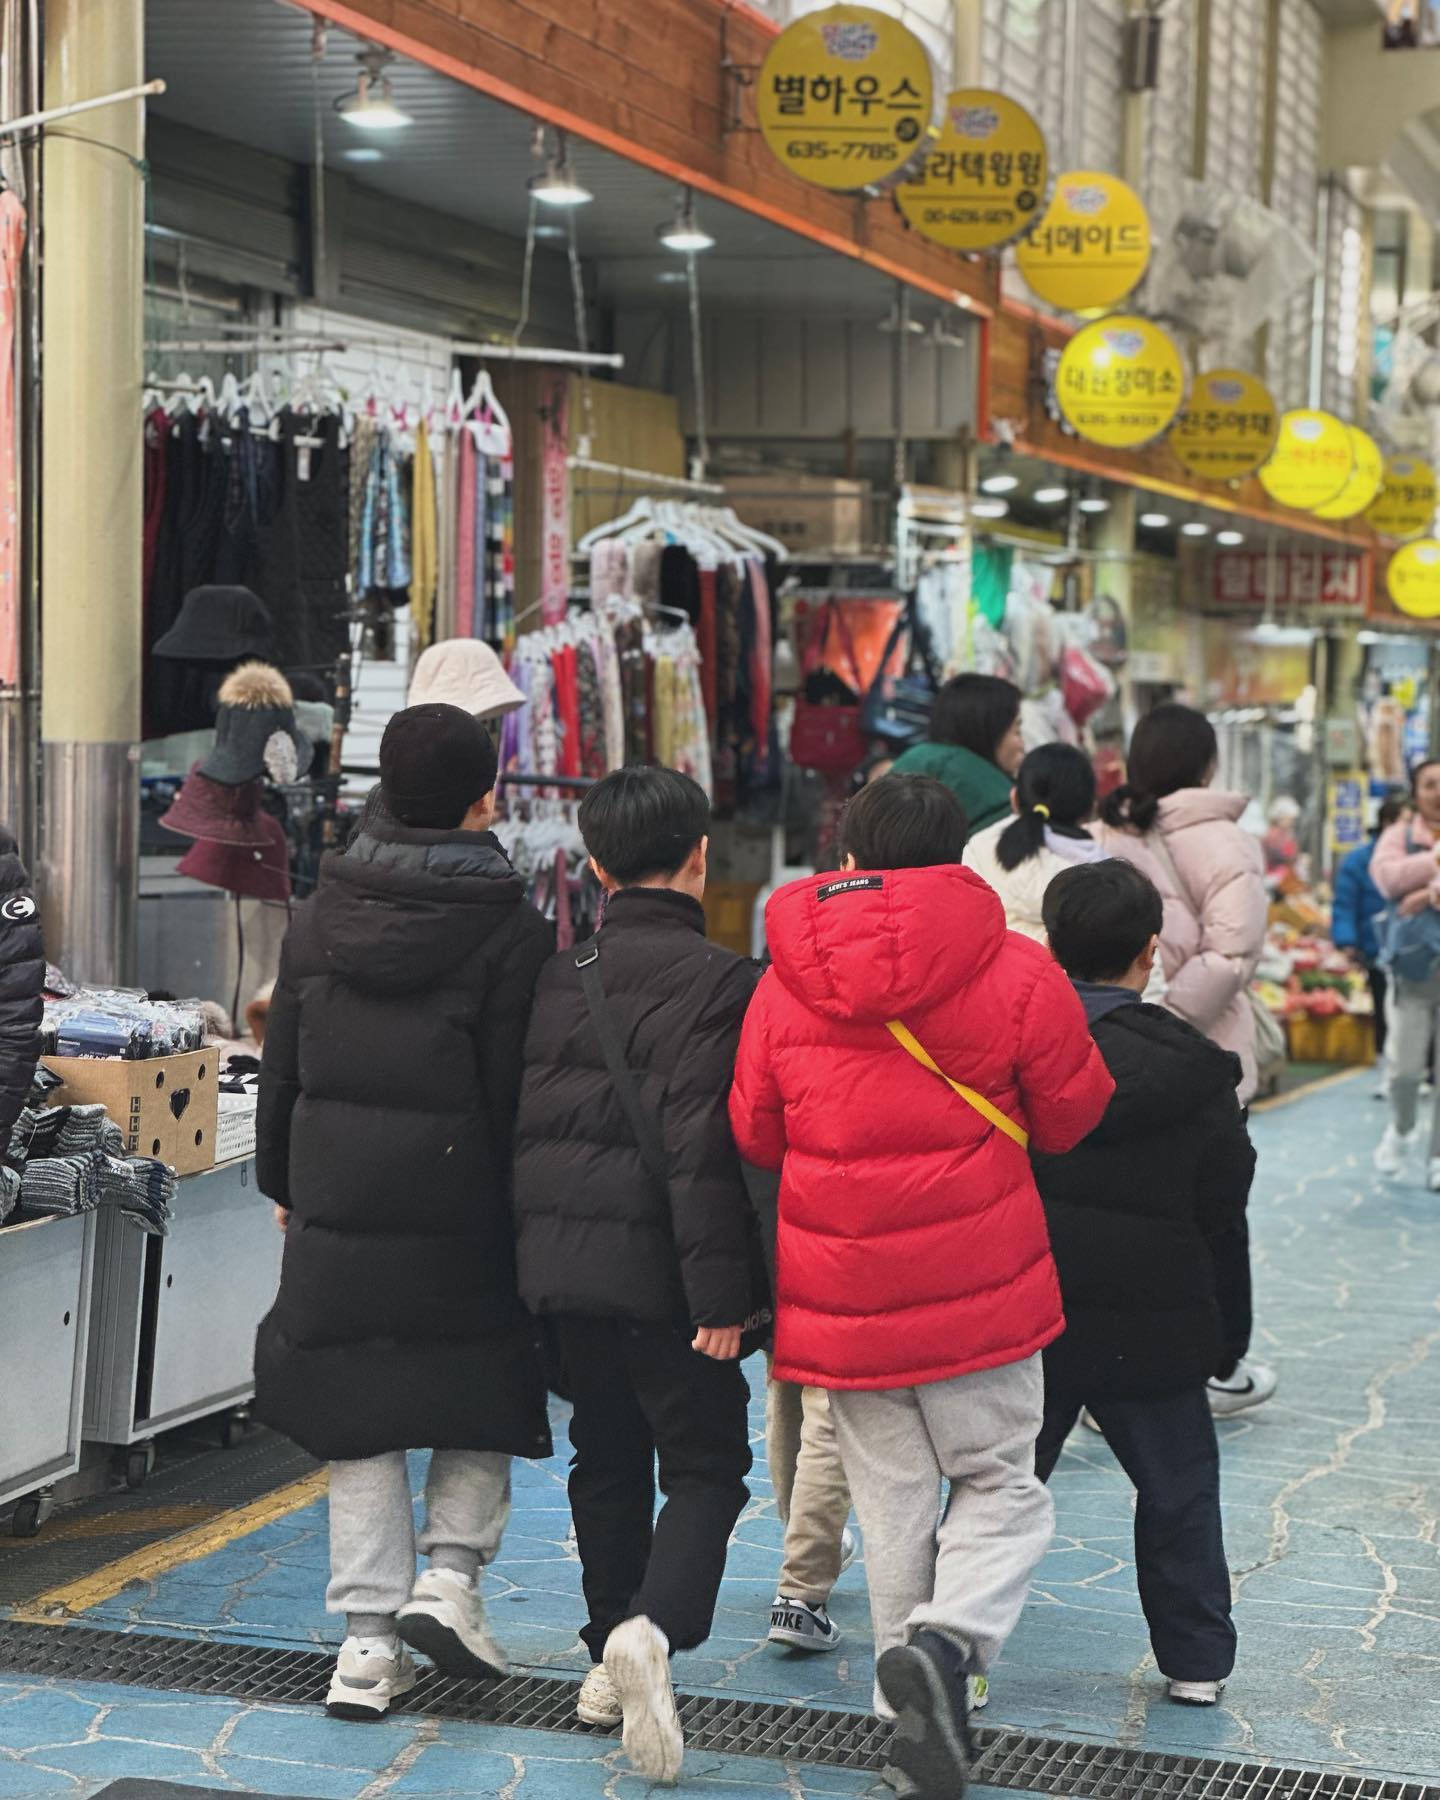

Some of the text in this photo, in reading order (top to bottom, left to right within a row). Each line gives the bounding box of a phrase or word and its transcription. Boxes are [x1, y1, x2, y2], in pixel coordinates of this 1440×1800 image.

[773, 75, 924, 116] 별하우스
[1027, 224, 1144, 257] 더메이드
[770, 1611, 804, 1631] NIKE
